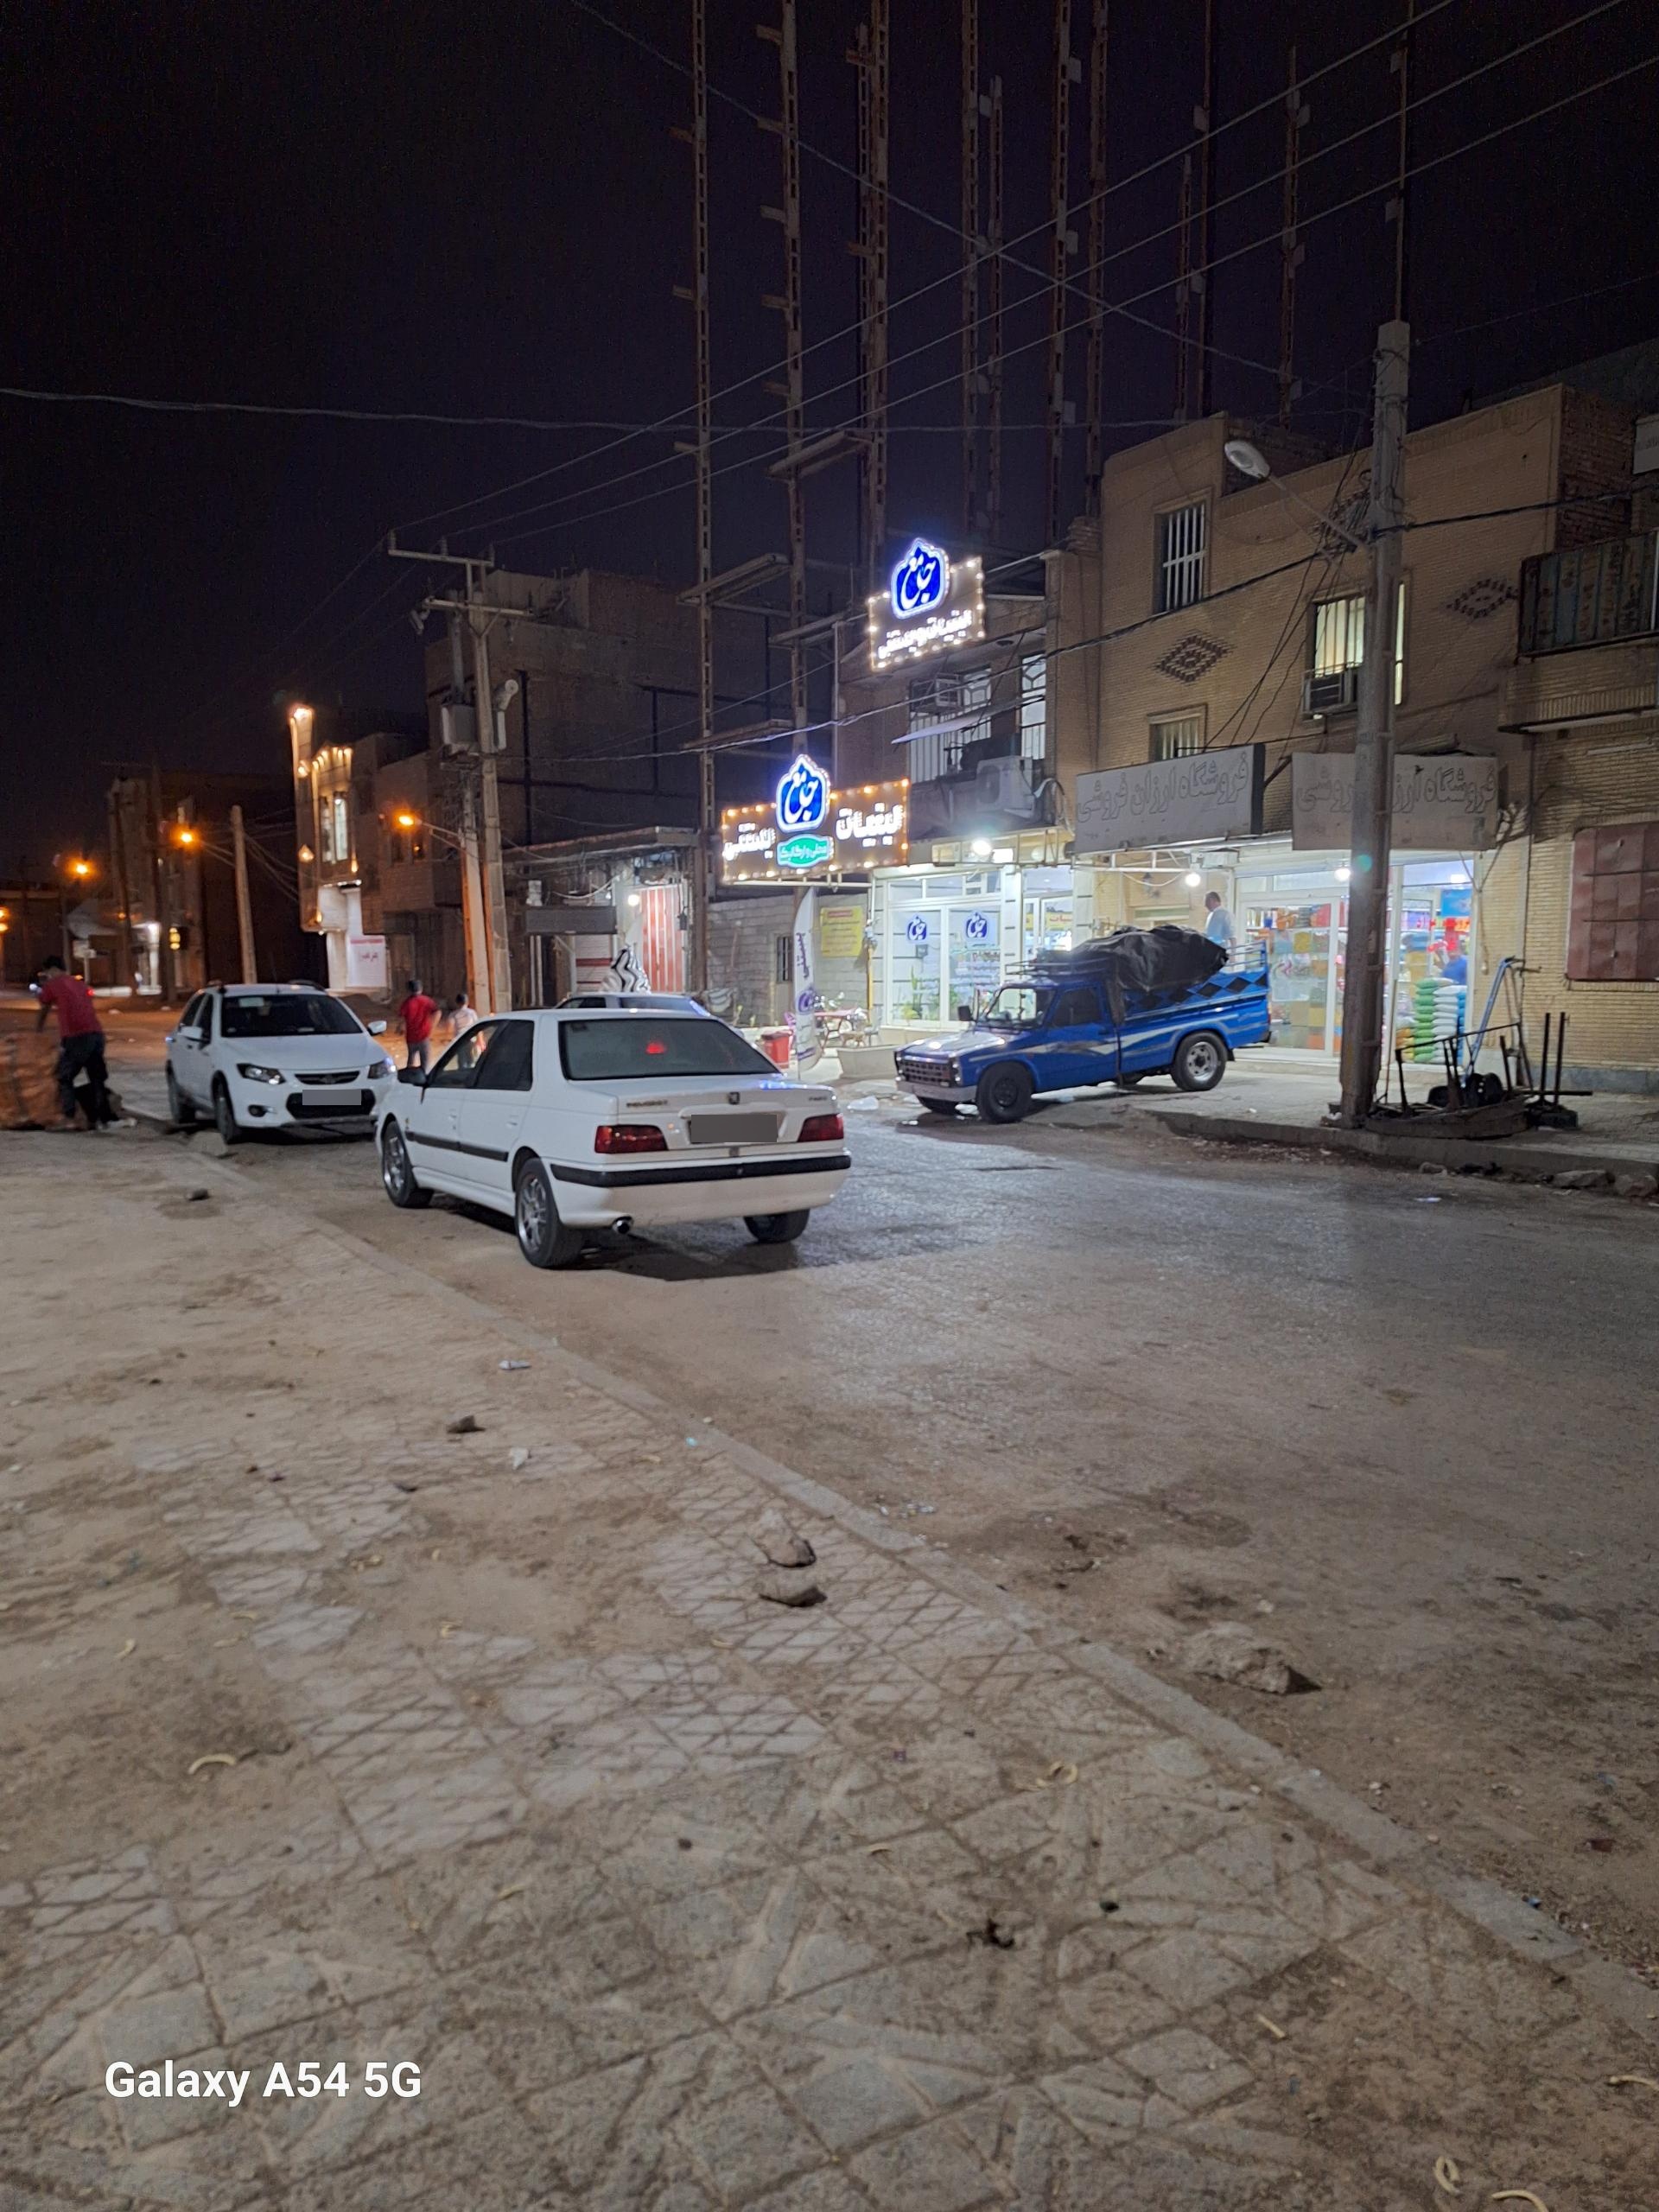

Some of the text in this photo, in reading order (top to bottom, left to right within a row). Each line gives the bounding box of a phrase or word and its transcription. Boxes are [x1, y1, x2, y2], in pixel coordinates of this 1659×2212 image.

[1077, 751, 1249, 823] فروشگاه ارزان فروشی
[1298, 765, 1496, 813] فروشگاه ارز روشی
[722, 803, 903, 861] لبنیات بستنی
